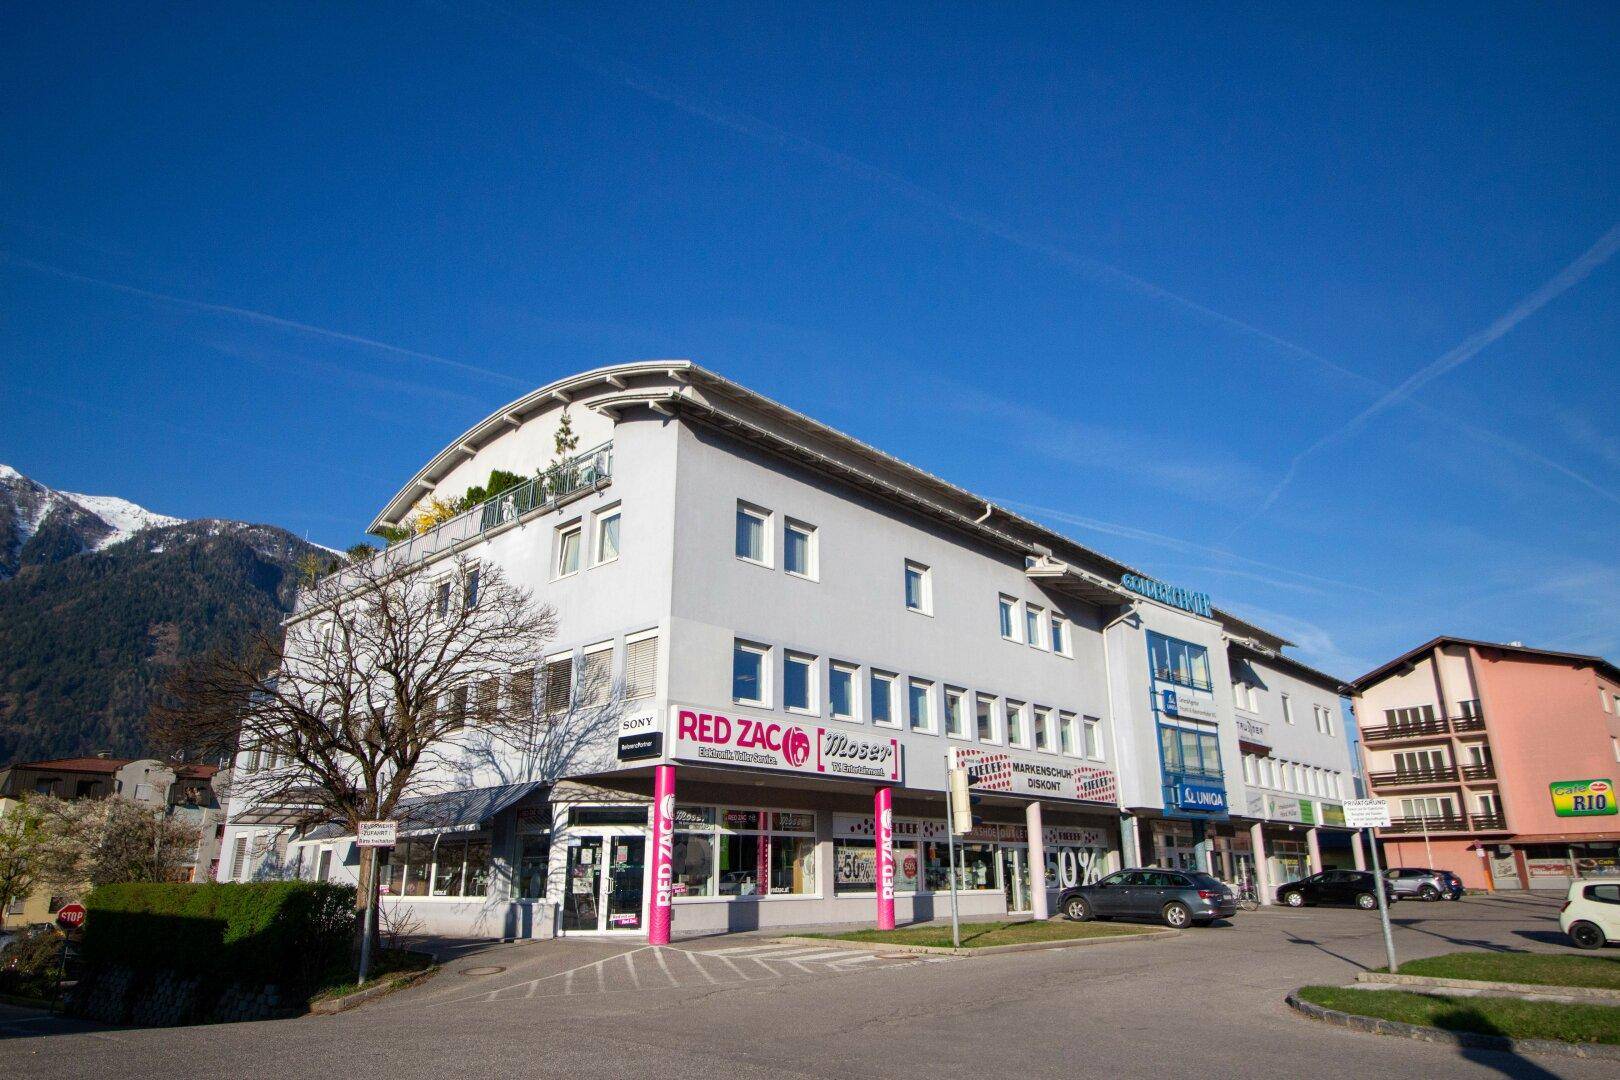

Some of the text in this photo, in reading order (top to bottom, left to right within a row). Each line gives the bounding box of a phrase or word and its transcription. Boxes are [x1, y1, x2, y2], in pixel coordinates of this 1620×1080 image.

[622, 717, 654, 730] SONY
[678, 710, 782, 751] RED ZAC
[698, 746, 778, 765] Elektronik. Voller Service.
[825, 731, 892, 763] Moser
[1012, 762, 1074, 779] MARKENSCHUH-
[1027, 778, 1061, 791] DISKONT
[1196, 791, 1223, 806] UNIQA
[1343, 799, 1386, 807] PRIVATGRUND
[1573, 794, 1606, 811] RIO
[980, 827, 997, 838] SHOE
[657, 820, 674, 906] RED ZAC
[881, 827, 894, 900] RED ZAC
[61, 911, 83, 922] STOP
